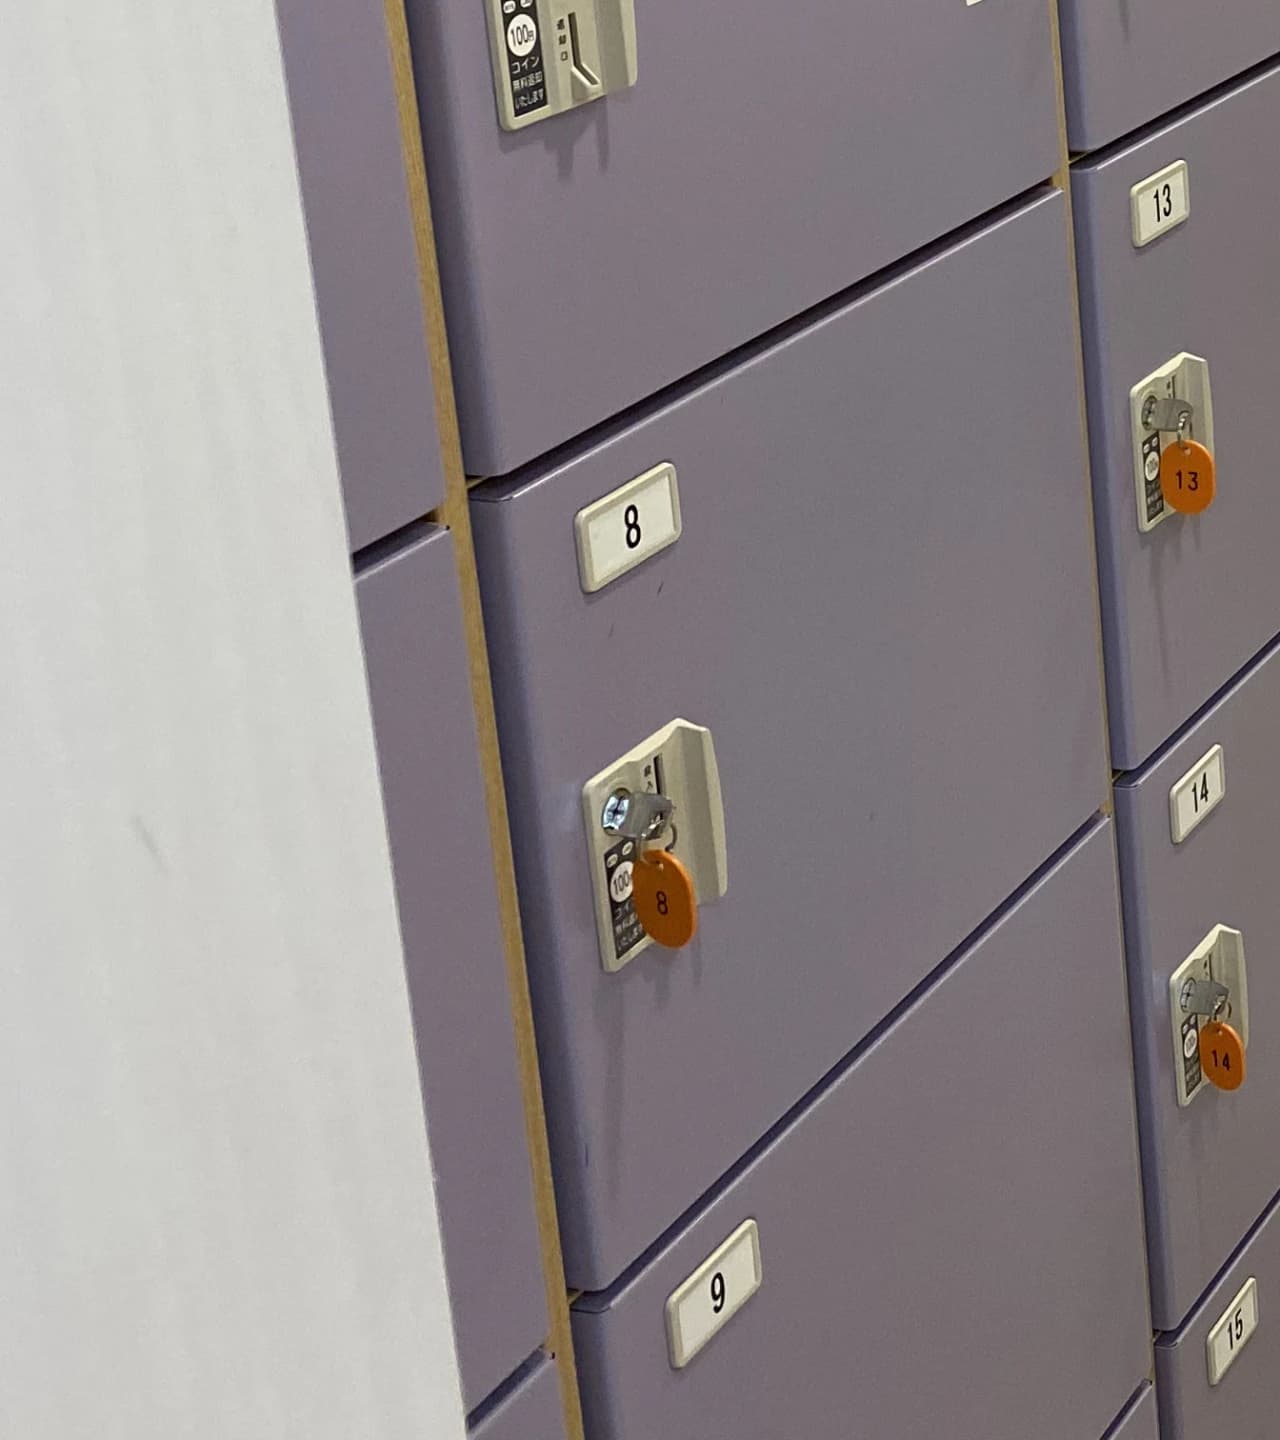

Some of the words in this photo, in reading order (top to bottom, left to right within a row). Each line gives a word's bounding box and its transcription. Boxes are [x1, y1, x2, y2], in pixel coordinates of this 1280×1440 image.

[510, 23, 535, 47] 100円
[511, 55, 540, 74] コイン
[1153, 183, 1172, 223] 13
[1175, 469, 1199, 492] 13
[624, 504, 642, 549] 8
[1191, 772, 1209, 813] 14
[655, 890, 669, 916] 8
[1211, 1049, 1231, 1071] 14
[710, 1272, 726, 1314] 9
[1227, 1307, 1244, 1350] 15
